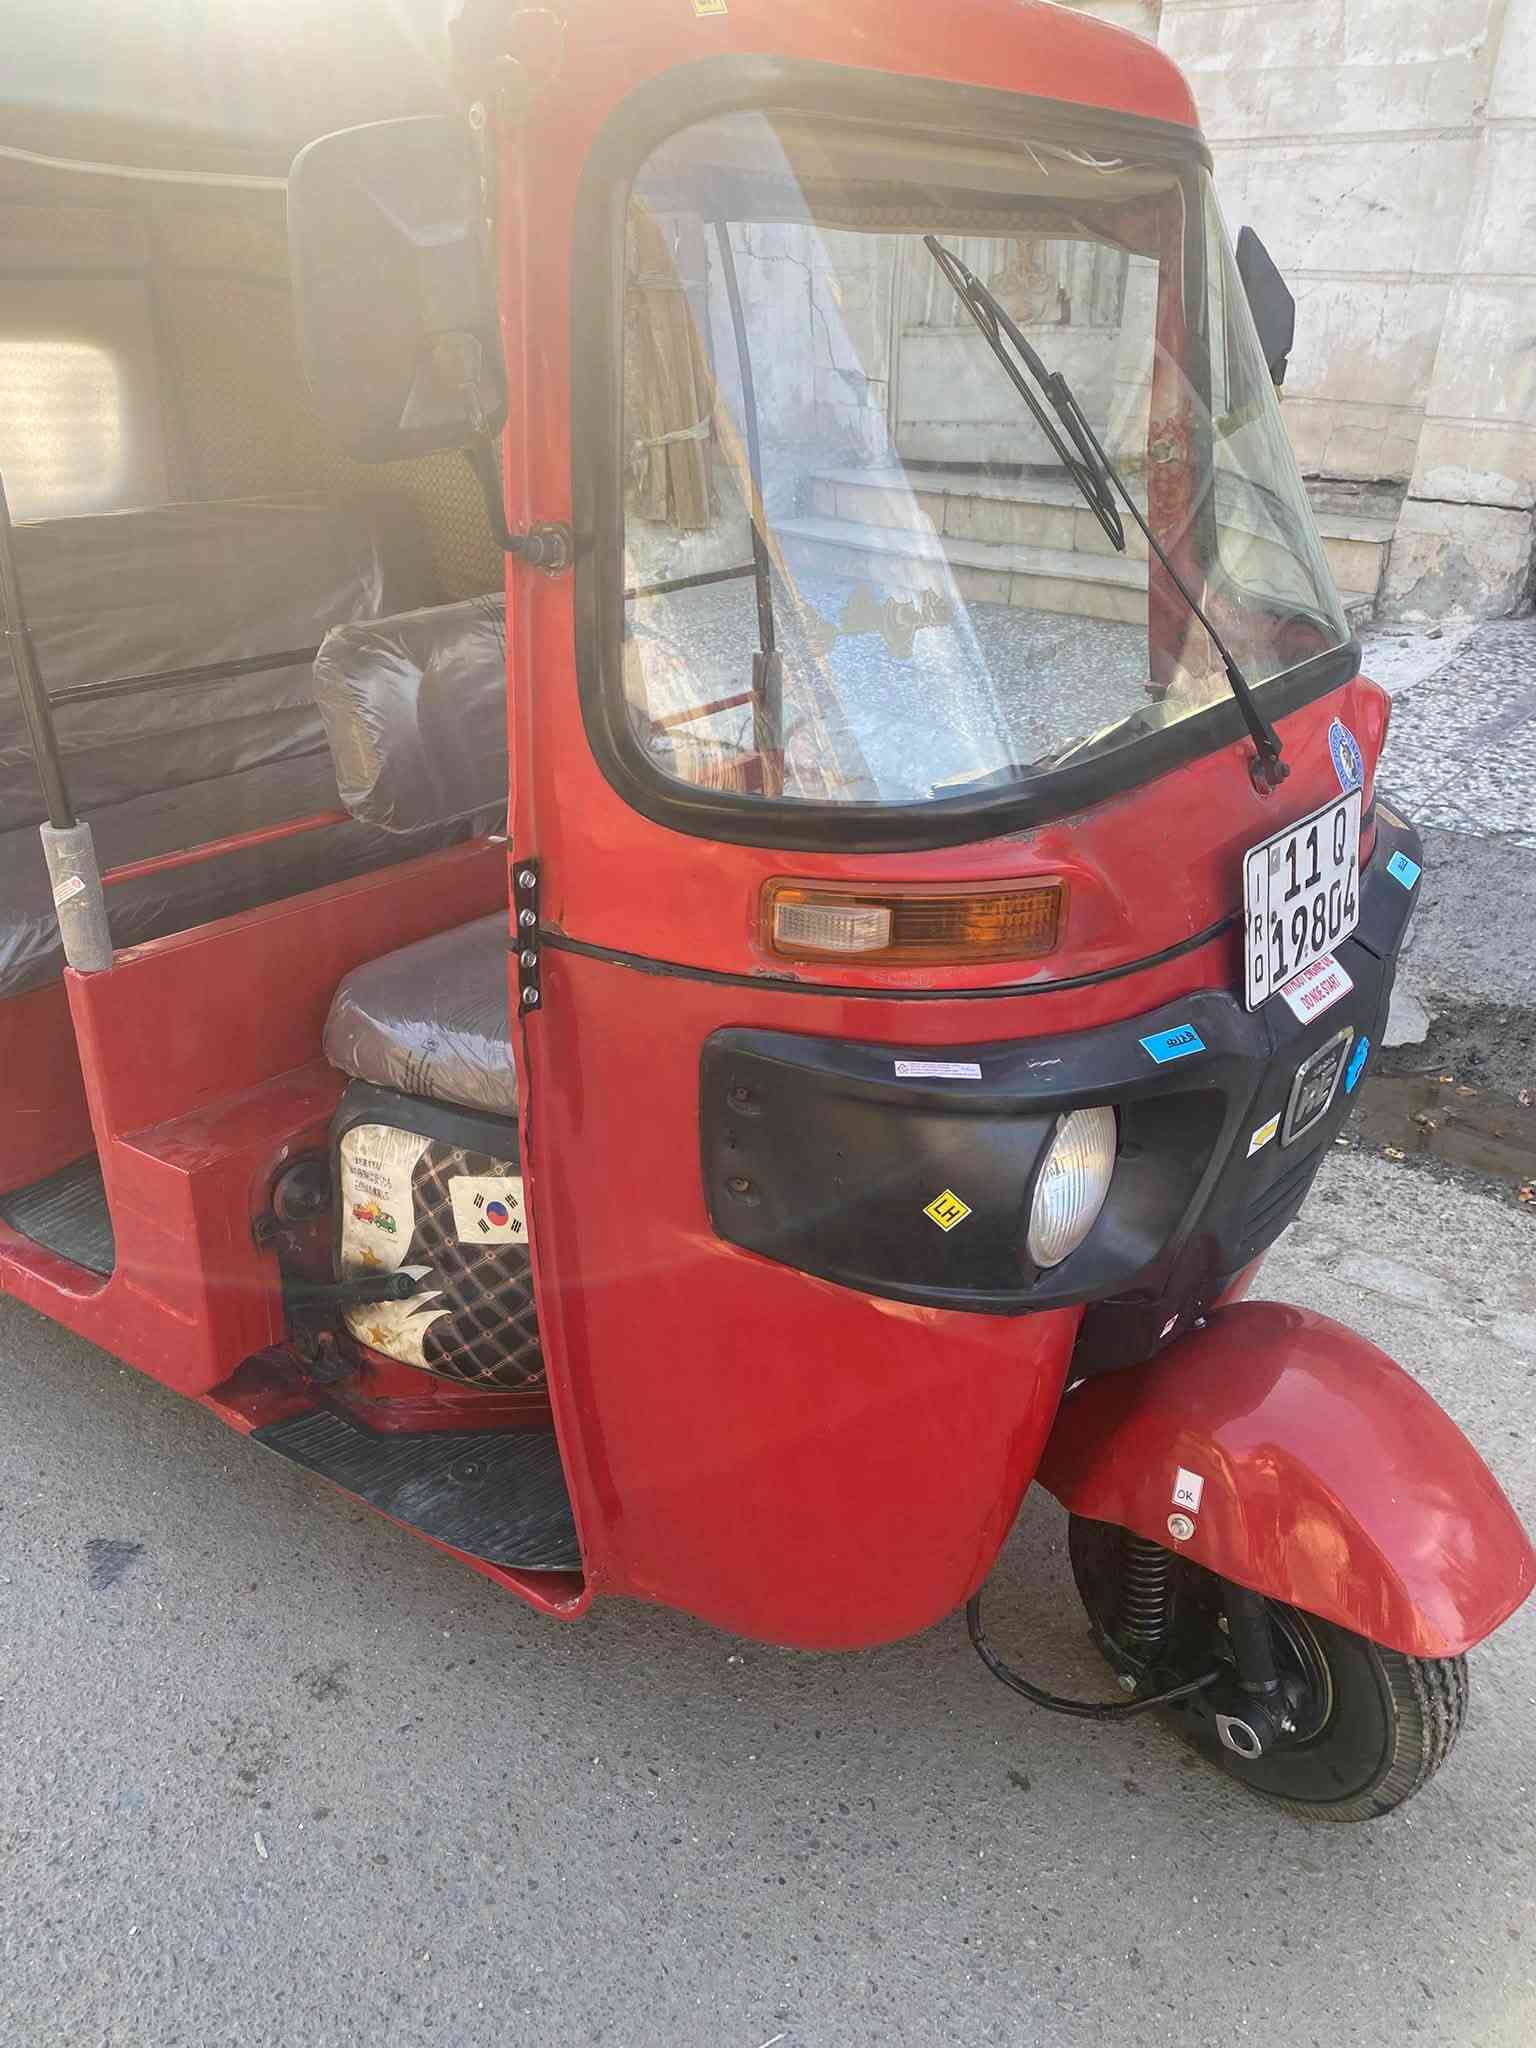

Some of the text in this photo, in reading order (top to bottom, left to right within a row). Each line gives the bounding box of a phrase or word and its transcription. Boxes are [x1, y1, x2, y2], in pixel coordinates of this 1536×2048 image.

[1284, 807, 1346, 902] 11 Q
[1272, 861, 1356, 984] 19804
[934, 1198, 960, 1222] LH
[1177, 1489, 1193, 1502] OK
